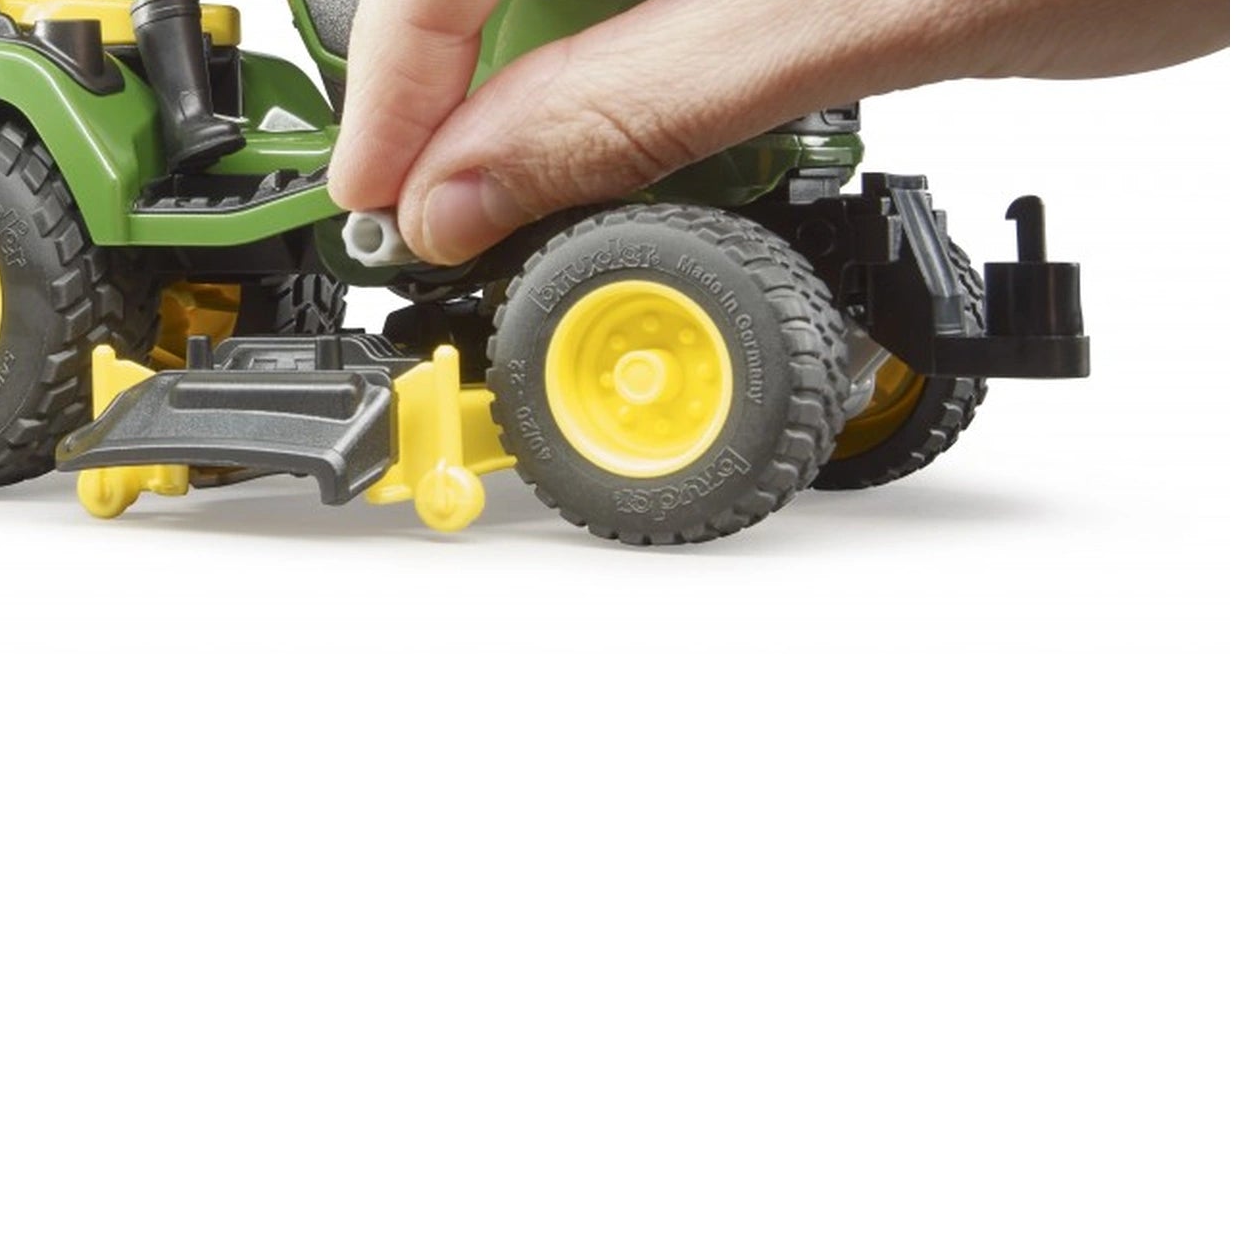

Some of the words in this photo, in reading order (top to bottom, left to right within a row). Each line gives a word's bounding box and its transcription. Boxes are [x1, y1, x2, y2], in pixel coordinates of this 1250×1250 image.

[528, 238, 660, 312] bruder
[676, 254, 722, 294] Made
[735, 313, 764, 404] Germany
[615, 446, 752, 521] bruder
